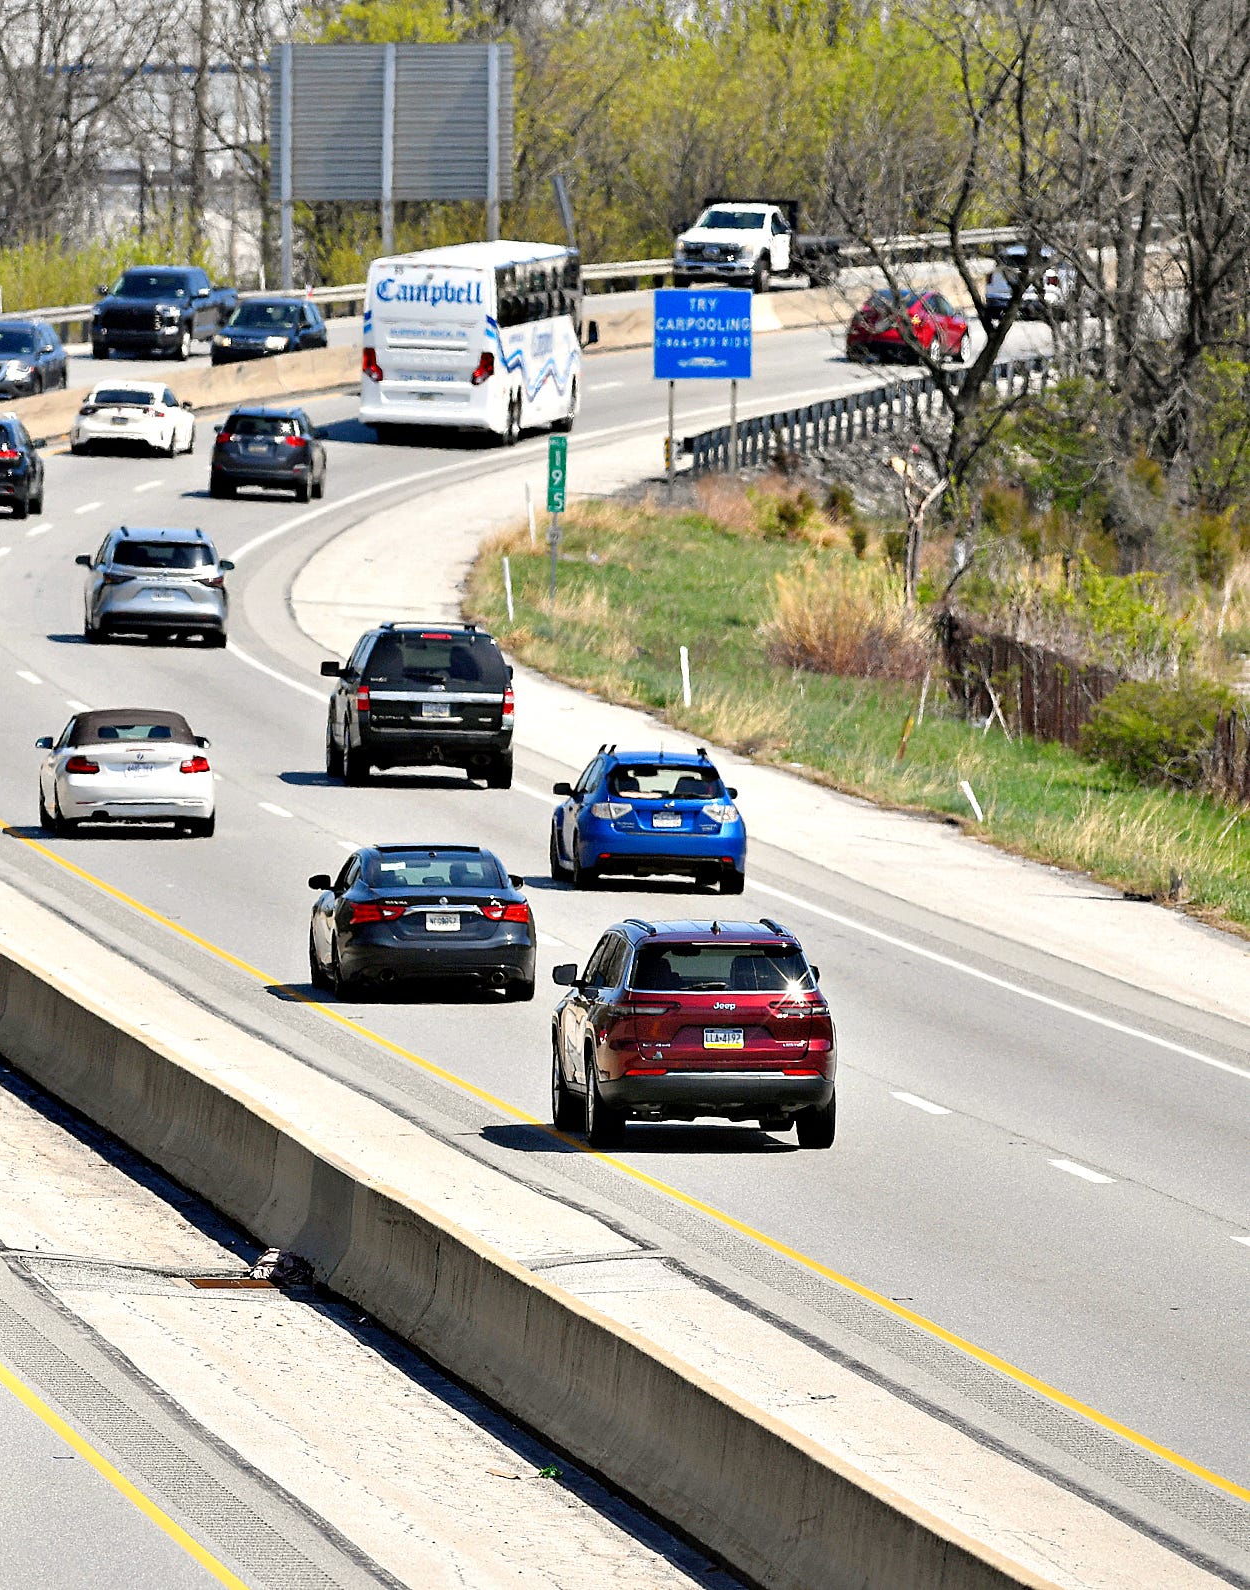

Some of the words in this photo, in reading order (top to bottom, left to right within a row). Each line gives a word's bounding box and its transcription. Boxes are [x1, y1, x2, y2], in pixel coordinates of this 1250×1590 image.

[376, 278, 483, 307] Campbell
[689, 298, 718, 311] TRY
[655, 317, 750, 331] CARPOOLING
[713, 1002, 736, 1011] Jeep
